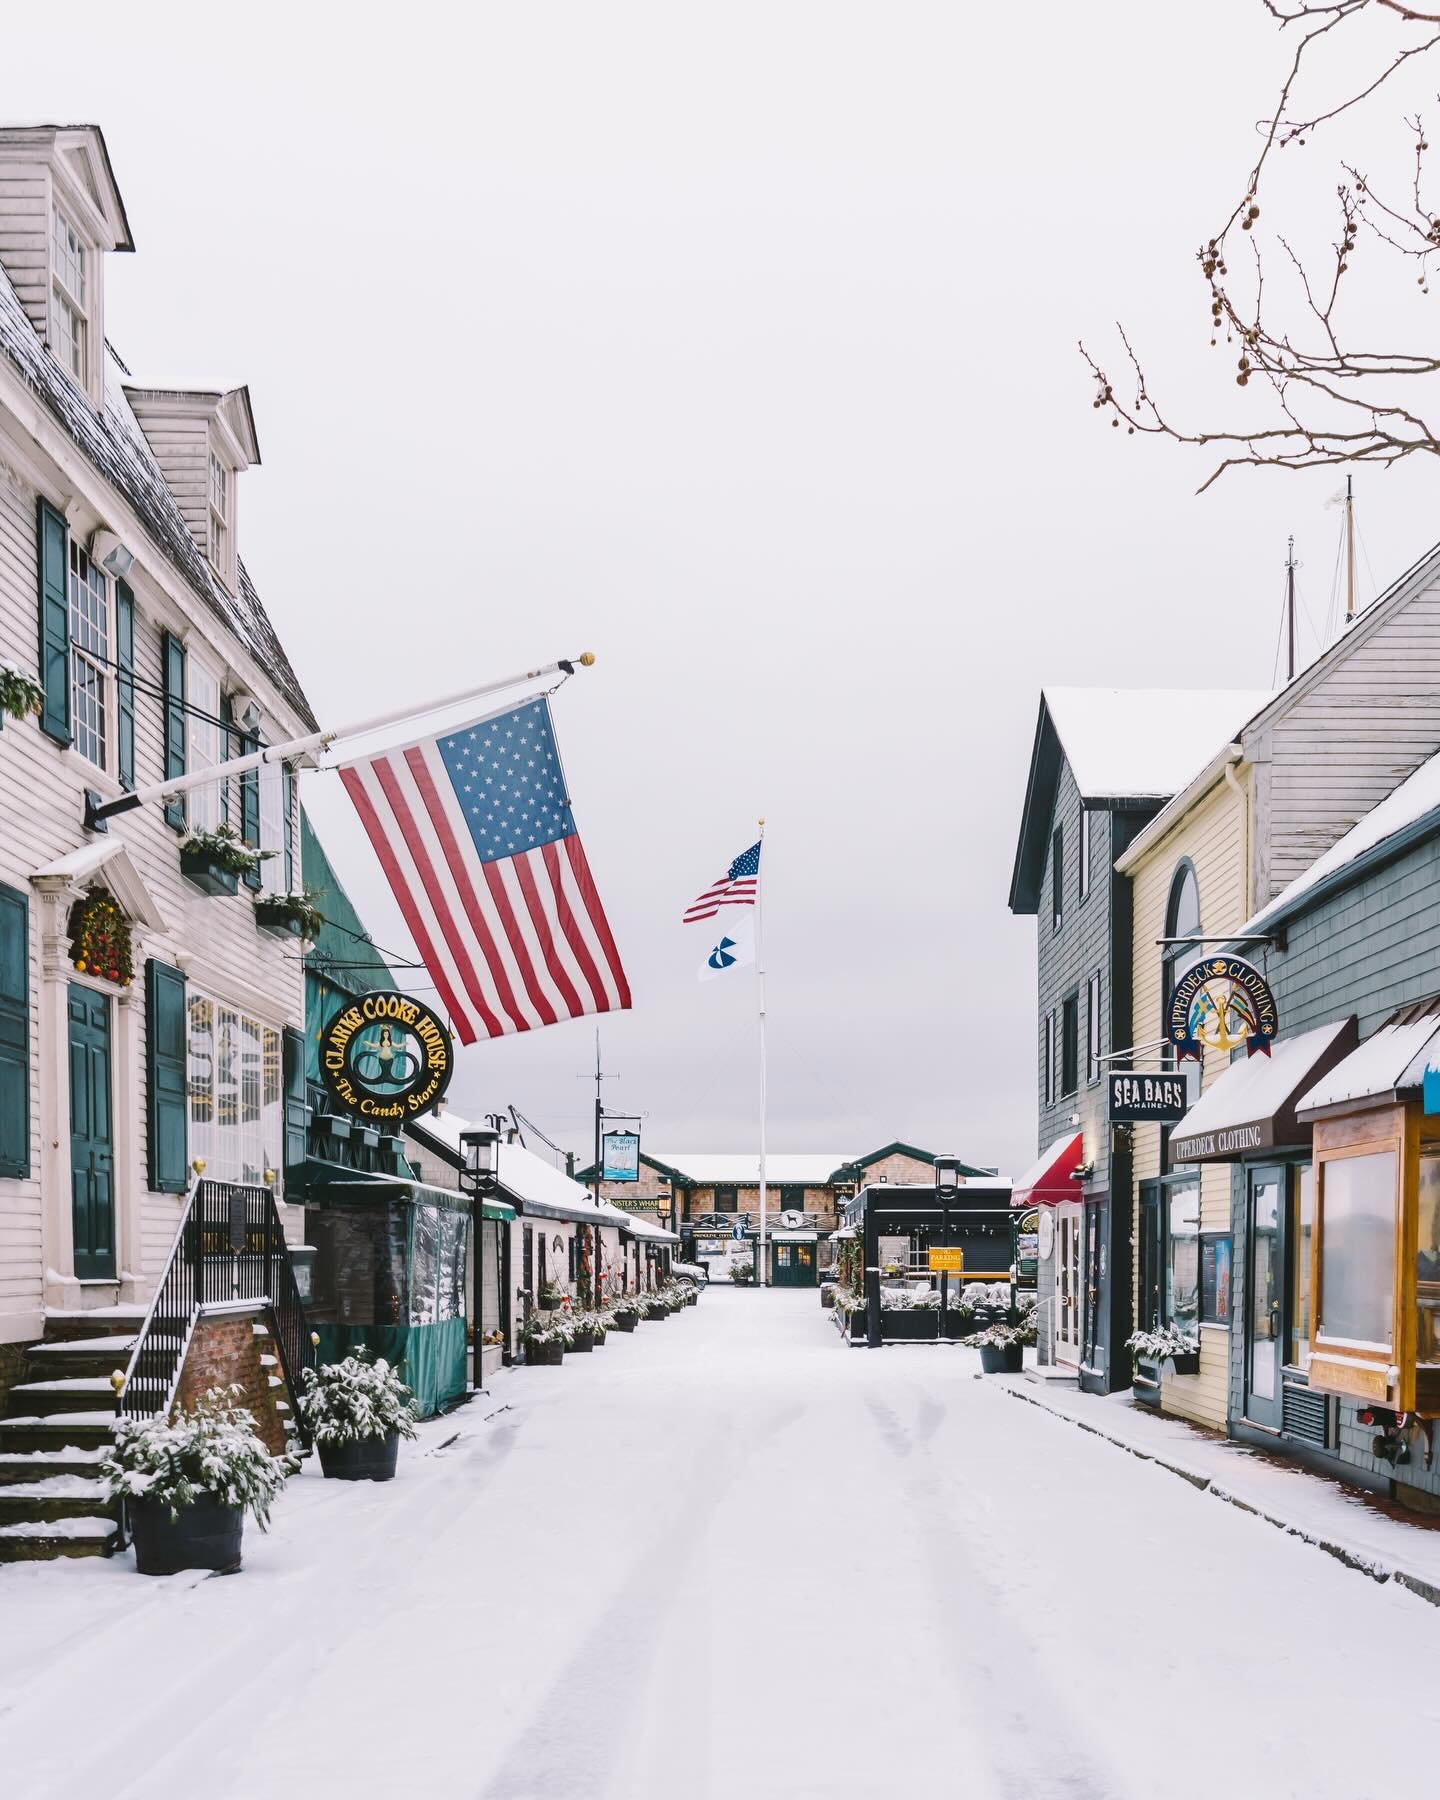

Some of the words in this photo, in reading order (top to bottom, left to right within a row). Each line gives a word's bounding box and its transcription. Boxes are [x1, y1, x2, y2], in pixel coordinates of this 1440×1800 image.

[1171, 963, 1214, 1028] UPPERDECK
[1228, 962, 1274, 1023] CLOTHING
[326, 1006, 365, 1070] CLARKE
[363, 995, 420, 1025] COOKE
[414, 1015, 446, 1070] HOUSE
[335, 1078, 358, 1105] The
[360, 1099, 404, 1118] Candy
[408, 1079, 439, 1110] Store
[1114, 1078, 1140, 1108] SEA
[1144, 1079, 1182, 1108] BAGS
[611, 1143, 632, 1151] Pearl
[619, 1136, 637, 1145] Black
[1176, 1134, 1216, 1160] UPPERDECK
[1218, 1125, 1261, 1152] CLOTHING
